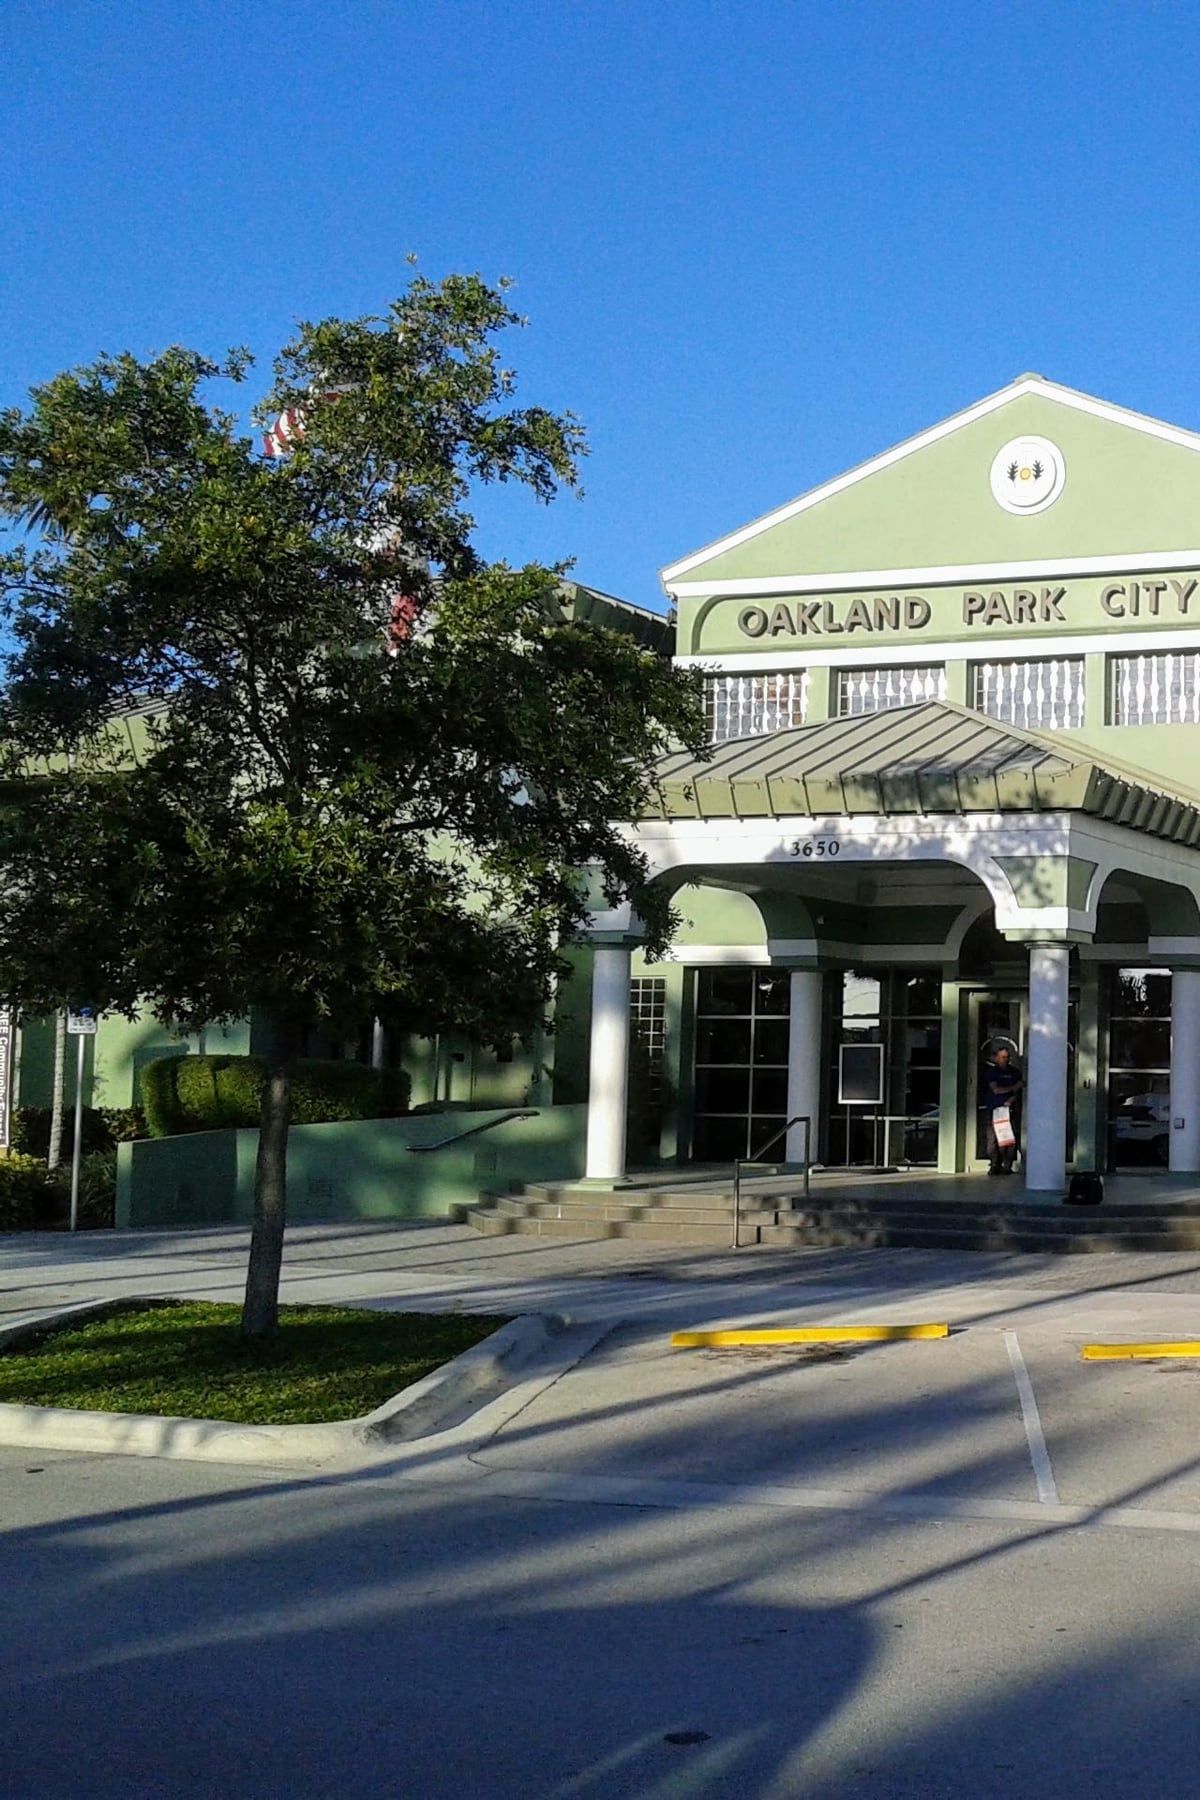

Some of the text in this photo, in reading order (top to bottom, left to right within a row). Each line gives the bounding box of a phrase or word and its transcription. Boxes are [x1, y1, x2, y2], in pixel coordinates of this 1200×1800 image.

[738, 596, 931, 638] OAKLAND
[963, 587, 1067, 625] PARK
[1100, 579, 1198, 617] CITY
[791, 841, 840, 856] 3650
